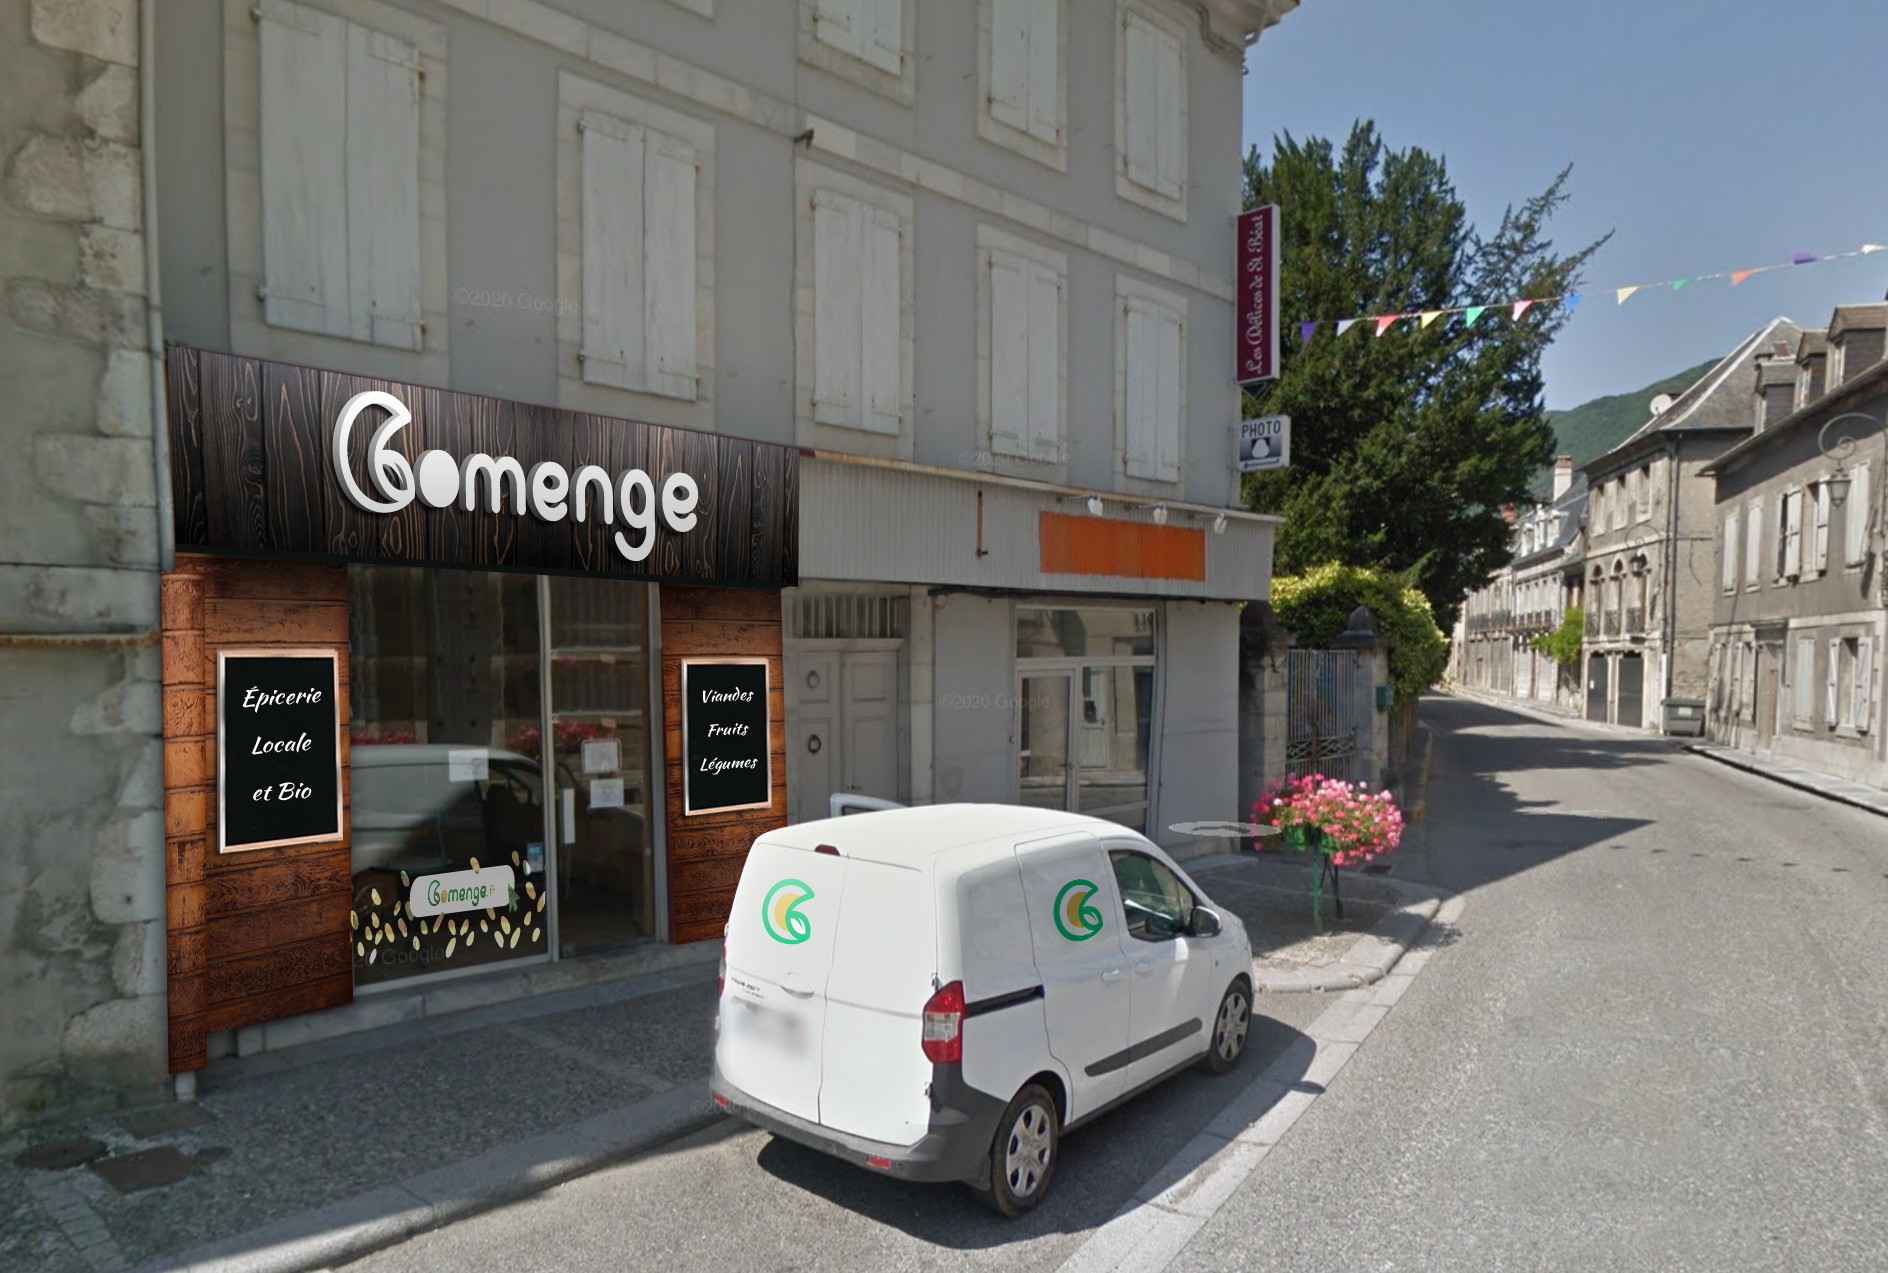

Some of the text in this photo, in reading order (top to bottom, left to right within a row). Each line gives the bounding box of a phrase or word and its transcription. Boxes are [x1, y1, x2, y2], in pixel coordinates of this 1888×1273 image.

[1246, 214, 1264, 374] Les Délices de St Béat
[1241, 420, 1281, 438] PHOTO
[243, 686, 322, 713] Épicerie
[702, 686, 755, 704] Viandes
[707, 722, 750, 738] Fruits
[251, 732, 312, 755] Locale
[700, 757, 759, 776] Légumes
[252, 782, 312, 802] et Bio
